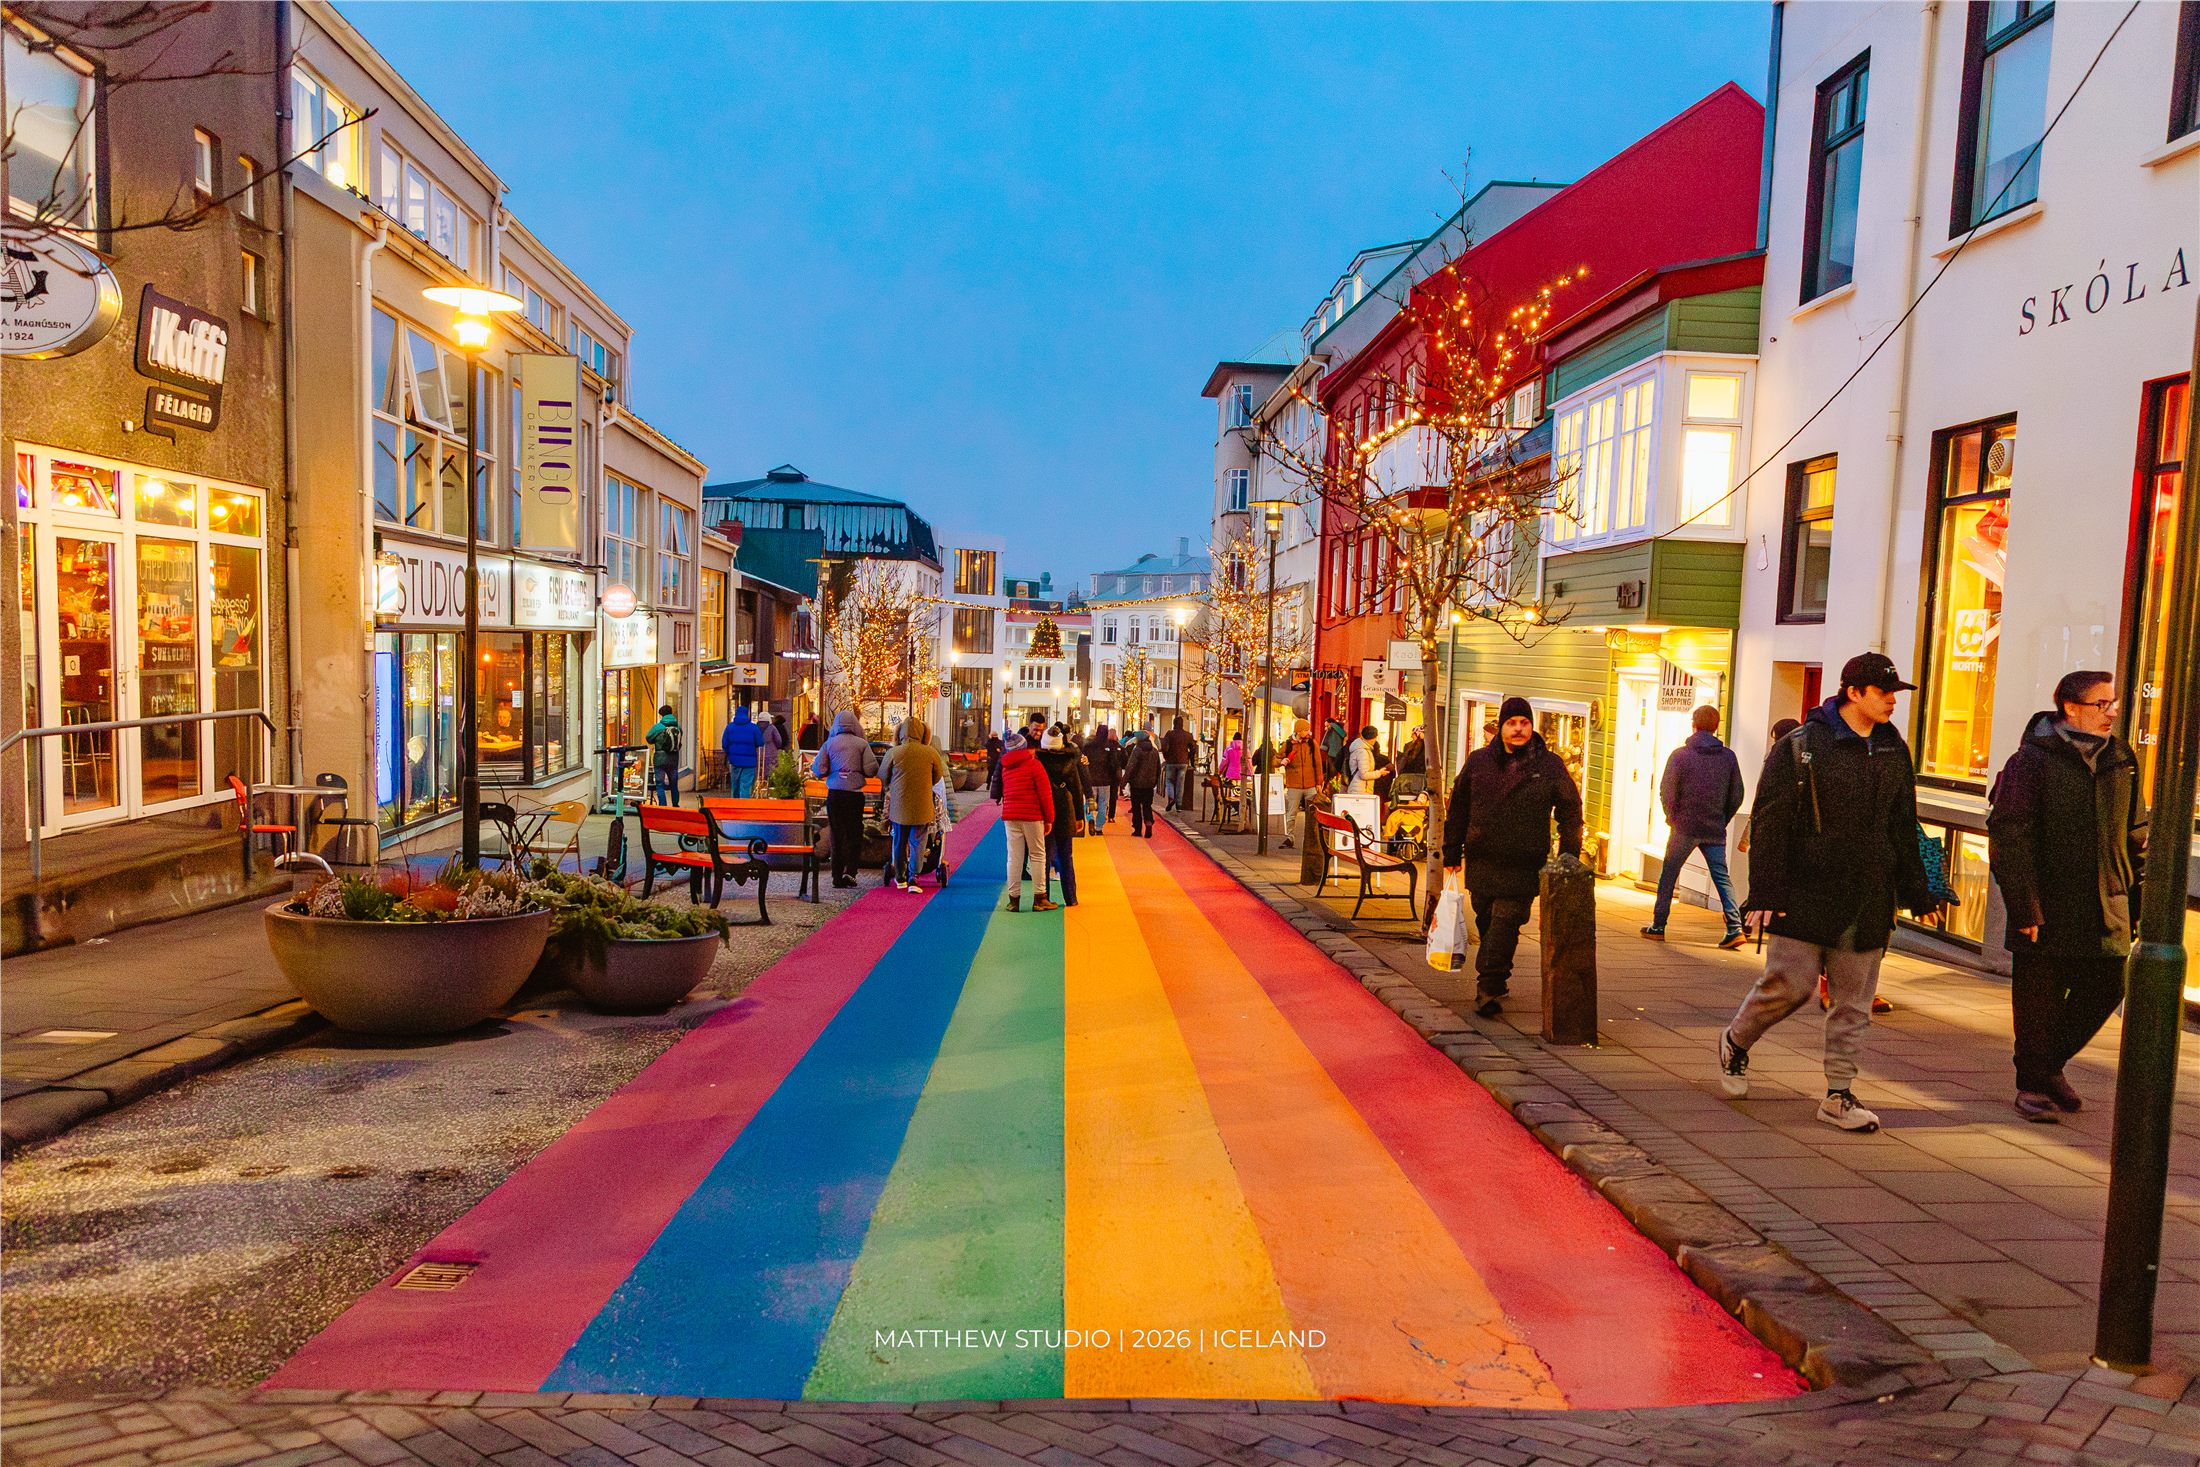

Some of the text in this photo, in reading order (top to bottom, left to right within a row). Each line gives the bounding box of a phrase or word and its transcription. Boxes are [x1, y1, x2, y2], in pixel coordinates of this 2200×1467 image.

[2019, 247, 2191, 337] SKÓLA
[9, 332, 34, 341] 1924
[148, 306, 227, 385] Kaffi
[155, 393, 213, 424] FÉLAGIÐ
[527, 412, 536, 493] DRINKERY
[538, 400, 572, 505] BINGO
[1661, 697, 1692, 707] SHOPPING
[1662, 687, 1692, 698] TAX FREE
